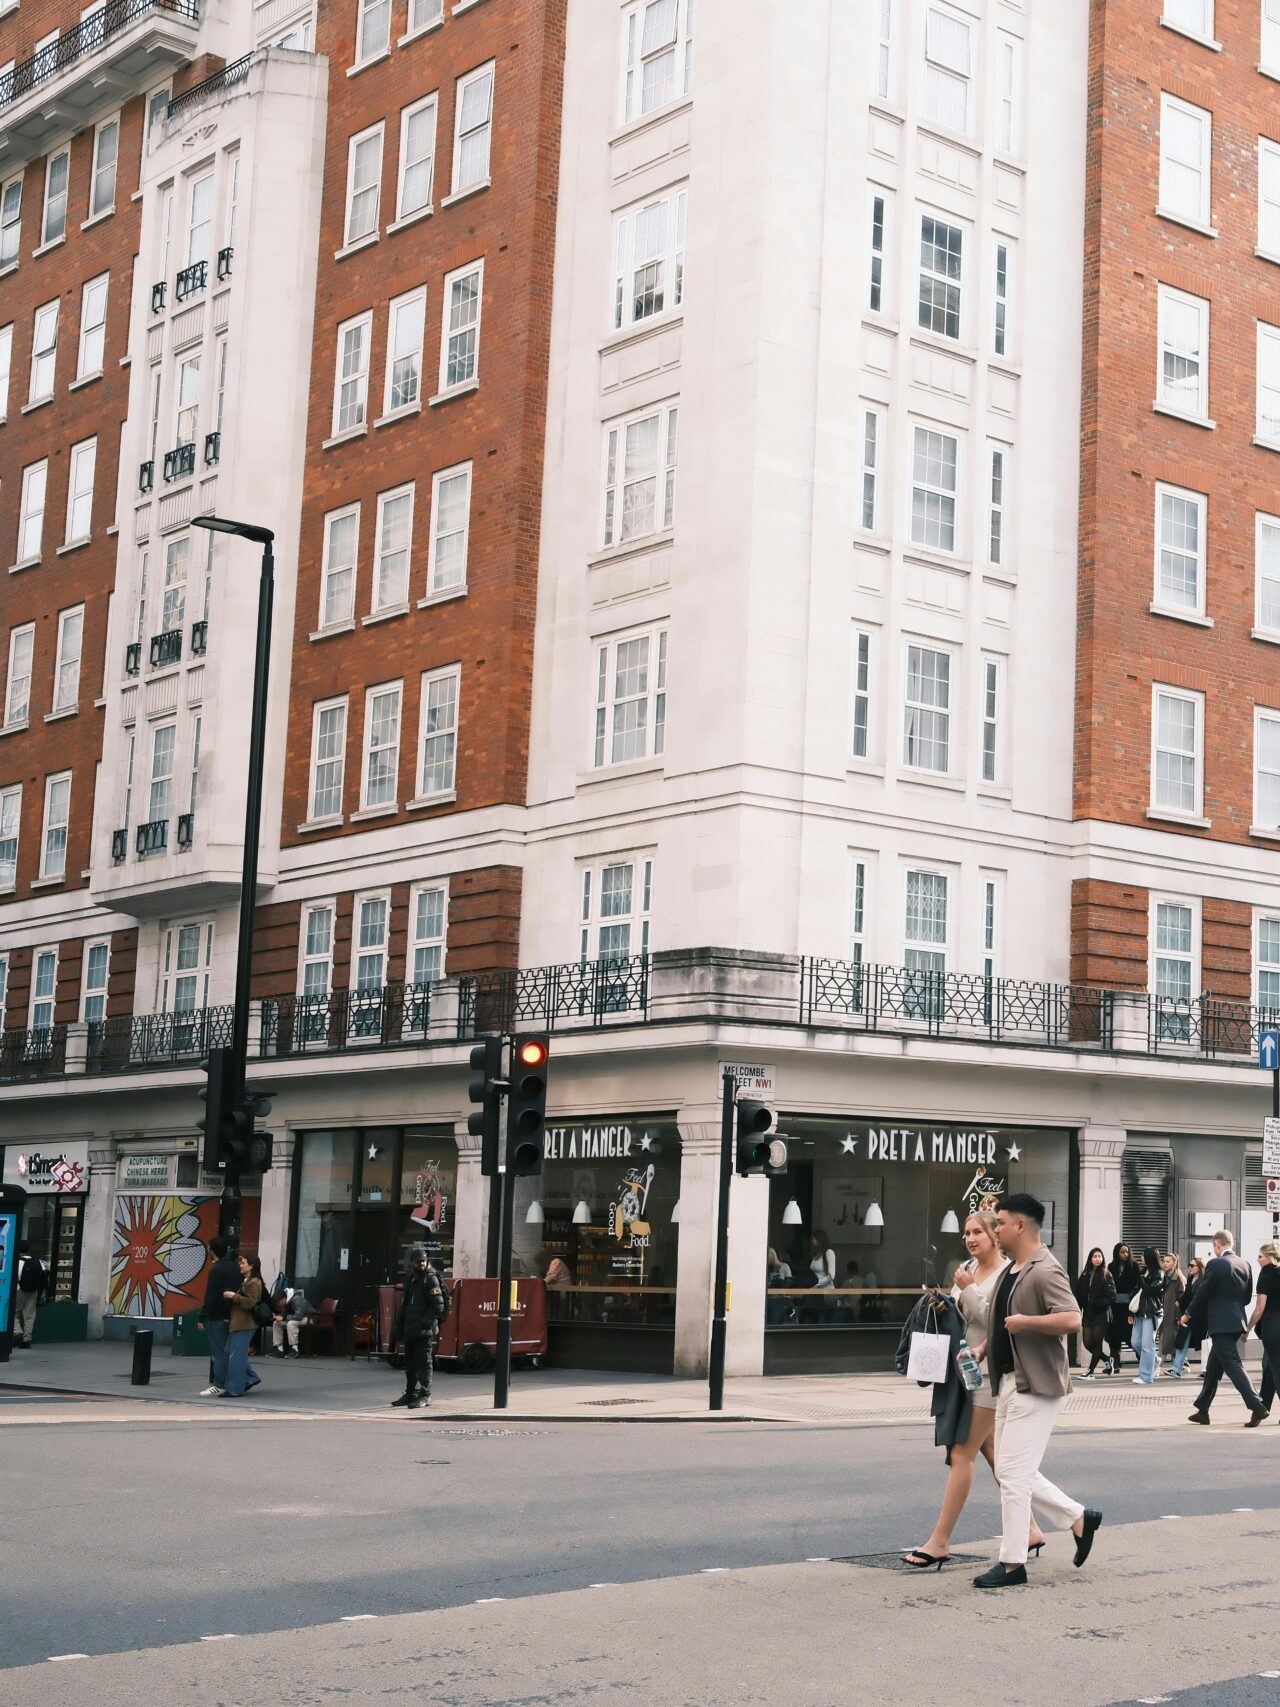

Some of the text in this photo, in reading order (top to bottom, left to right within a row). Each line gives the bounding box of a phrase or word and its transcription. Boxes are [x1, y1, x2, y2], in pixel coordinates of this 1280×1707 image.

[724, 1066, 765, 1078] MELCOMBE
[756, 1078, 772, 1088] NW1
[544, 1126, 632, 1159] RET A MANGER
[868, 1128, 996, 1164] PRET A MANGER
[128, 1157, 168, 1166] ACUPUNCTURE
[126, 1168, 149, 1176] CHINESE
[625, 1167, 647, 1184] Feel
[977, 1177, 1004, 1192] Feel
[969, 1193, 978, 1215] Goo
[608, 1202, 616, 1236] Good
[631, 1235, 650, 1247] Food.
[135, 1246, 148, 1258] 209
